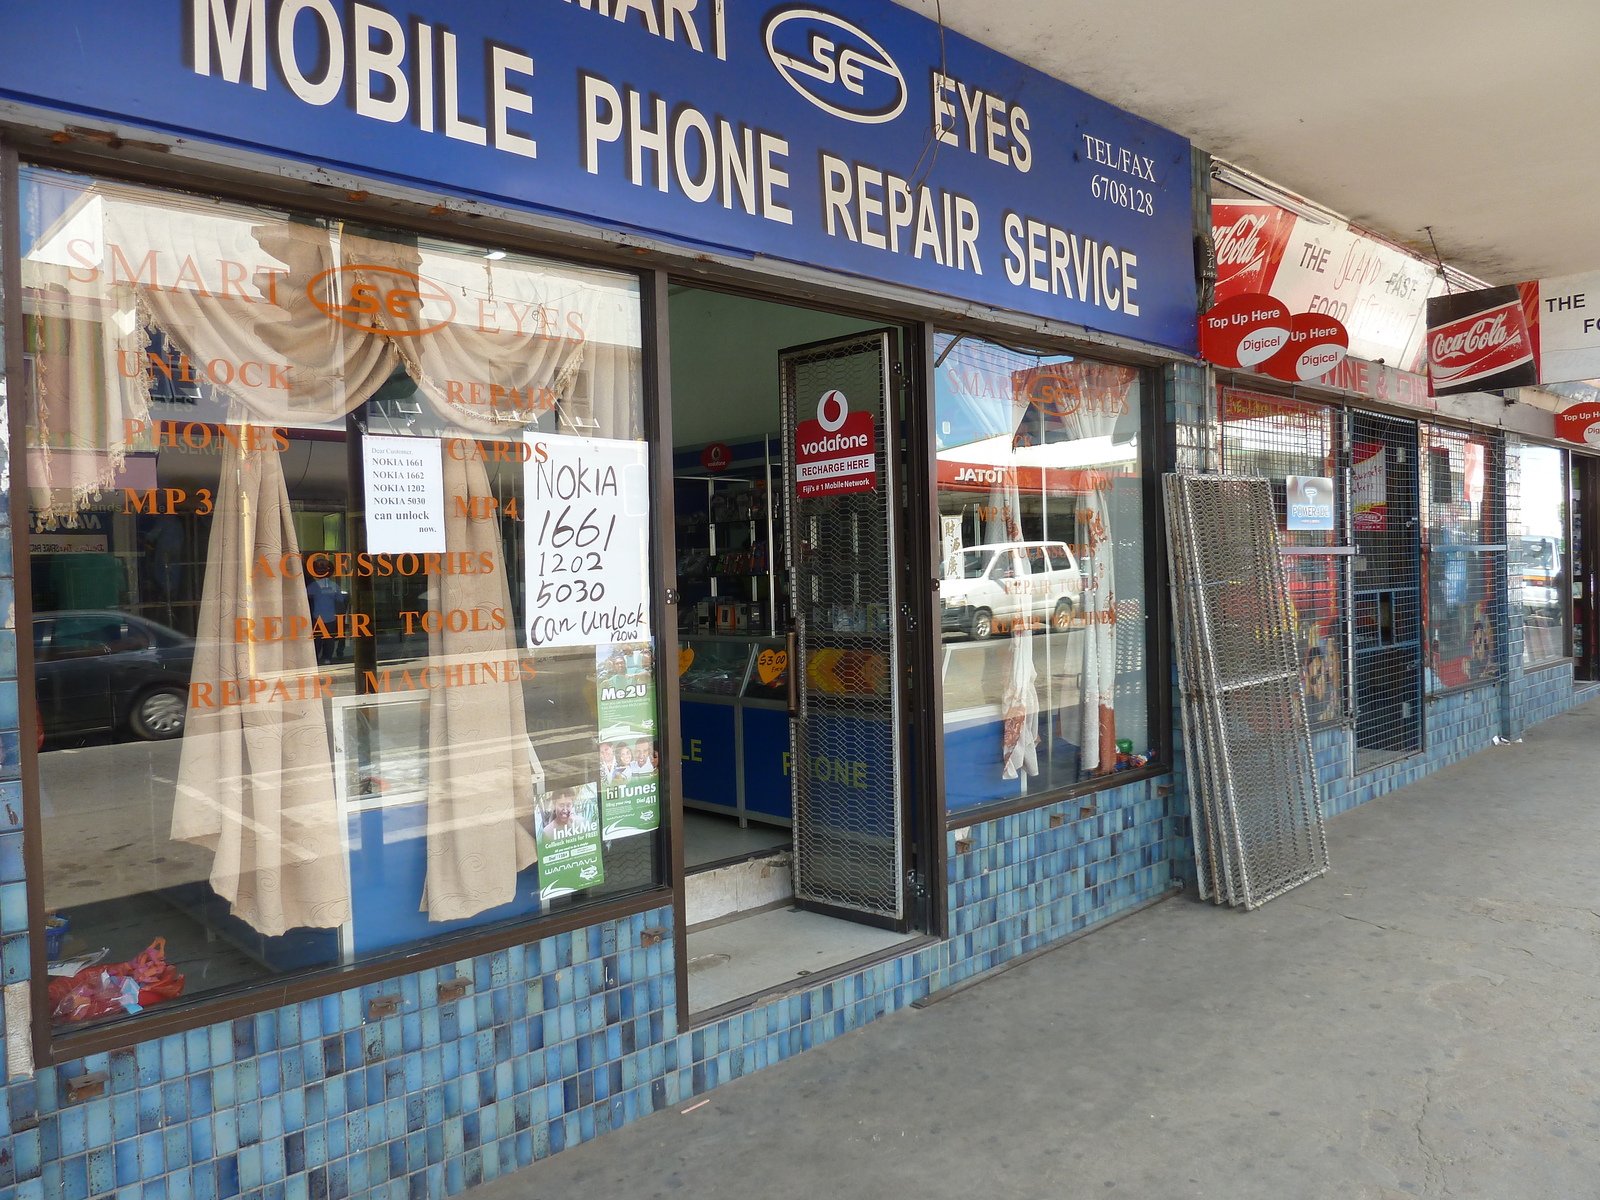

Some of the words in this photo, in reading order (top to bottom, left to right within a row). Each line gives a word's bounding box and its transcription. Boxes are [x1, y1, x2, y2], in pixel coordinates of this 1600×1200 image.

[933, 71, 1032, 173] EYES
[194, 0, 537, 159] MOBILE
[584, 75, 794, 226] PHONE
[822, 154, 983, 276] REPAIR
[1004, 212, 1140, 317] SERVICE
[1082, 133, 1157, 183] TEL/FAX
[1090, 174, 1154, 217] 6708128
[1299, 241, 1331, 273] THE
[1385, 272, 1418, 300] FAST
[65, 238, 290, 307] SMART
[474, 296, 586, 345] EYES
[1545, 293, 1586, 313] THE
[1207, 317, 1229, 329] Top
[1231, 313, 1249, 326] Up
[1251, 308, 1280, 321] Here
[1243, 335, 1281, 351] Digicel
[1290, 331, 1307, 342] Up
[1309, 326, 1338, 339] Here
[1432, 311, 1508, 363] Coca-Cola
[1302, 352, 1338, 366] Digicel
[115, 349, 296, 390] UNLOCK
[445, 379, 557, 411] REPAIR
[1320, 358, 1370, 395] WINE
[1375, 371, 1390, 400] &
[1396, 373, 1437, 411] DIN
[947, 368, 1024, 402] SMART
[1085, 388, 1129, 415] EYES
[1563, 413, 1578, 422] Top
[1579, 412, 1591, 421] Up
[122, 418, 290, 452] PHONES
[447, 437, 549, 465] CARDS
[1587, 427, 1600, 436] Dig
[801, 433, 868, 455] vodafone
[372, 457, 403, 466] NOKIA
[406, 458, 423, 467] 1661
[707, 459, 726, 467] vodafone
[801, 462, 845, 477] RECHARGE
[847, 458, 869, 470] HERE
[372, 471, 404, 479] NOKIA
[407, 472, 425, 480] 1662
[536, 457, 618, 500] NOKIA
[802, 485, 815, 494] Fiji's
[824, 481, 844, 490] Mobile
[844, 478, 870, 488] Network
[1071, 472, 1114, 491] CARDS
[373, 484, 405, 492] NOKIA
[407, 484, 425, 492] 1202
[123, 487, 187, 516] MP
[195, 487, 214, 516] 3
[373, 497, 406, 505] NOKIA
[407, 497, 426, 505] 5030
[454, 494, 499, 519] MP
[504, 496, 518, 519] 4
[374, 512, 392, 520] can
[396, 510, 430, 520] unlock
[976, 505, 999, 522] MP
[537, 505, 616, 551] 1661
[250, 550, 495, 579] ACCESSORIES
[538, 551, 603, 577] 1202
[536, 579, 605, 608] 5030
[1004, 579, 1054, 596] REPAIR
[1060, 577, 1099, 593] TOOLS
[233, 613, 374, 643] REPAIR
[398, 607, 506, 635] TOOLS
[991, 615, 1045, 634] REPAIR
[610, 629, 638, 642] now
[188, 673, 336, 709] REPAIR
[363, 658, 538, 695] MACHINES
[600, 684, 647, 701] Me2U
[782, 751, 868, 789] PONE
[606, 783, 656, 800] hiTunes
[553, 820, 598, 840] InkkMe
